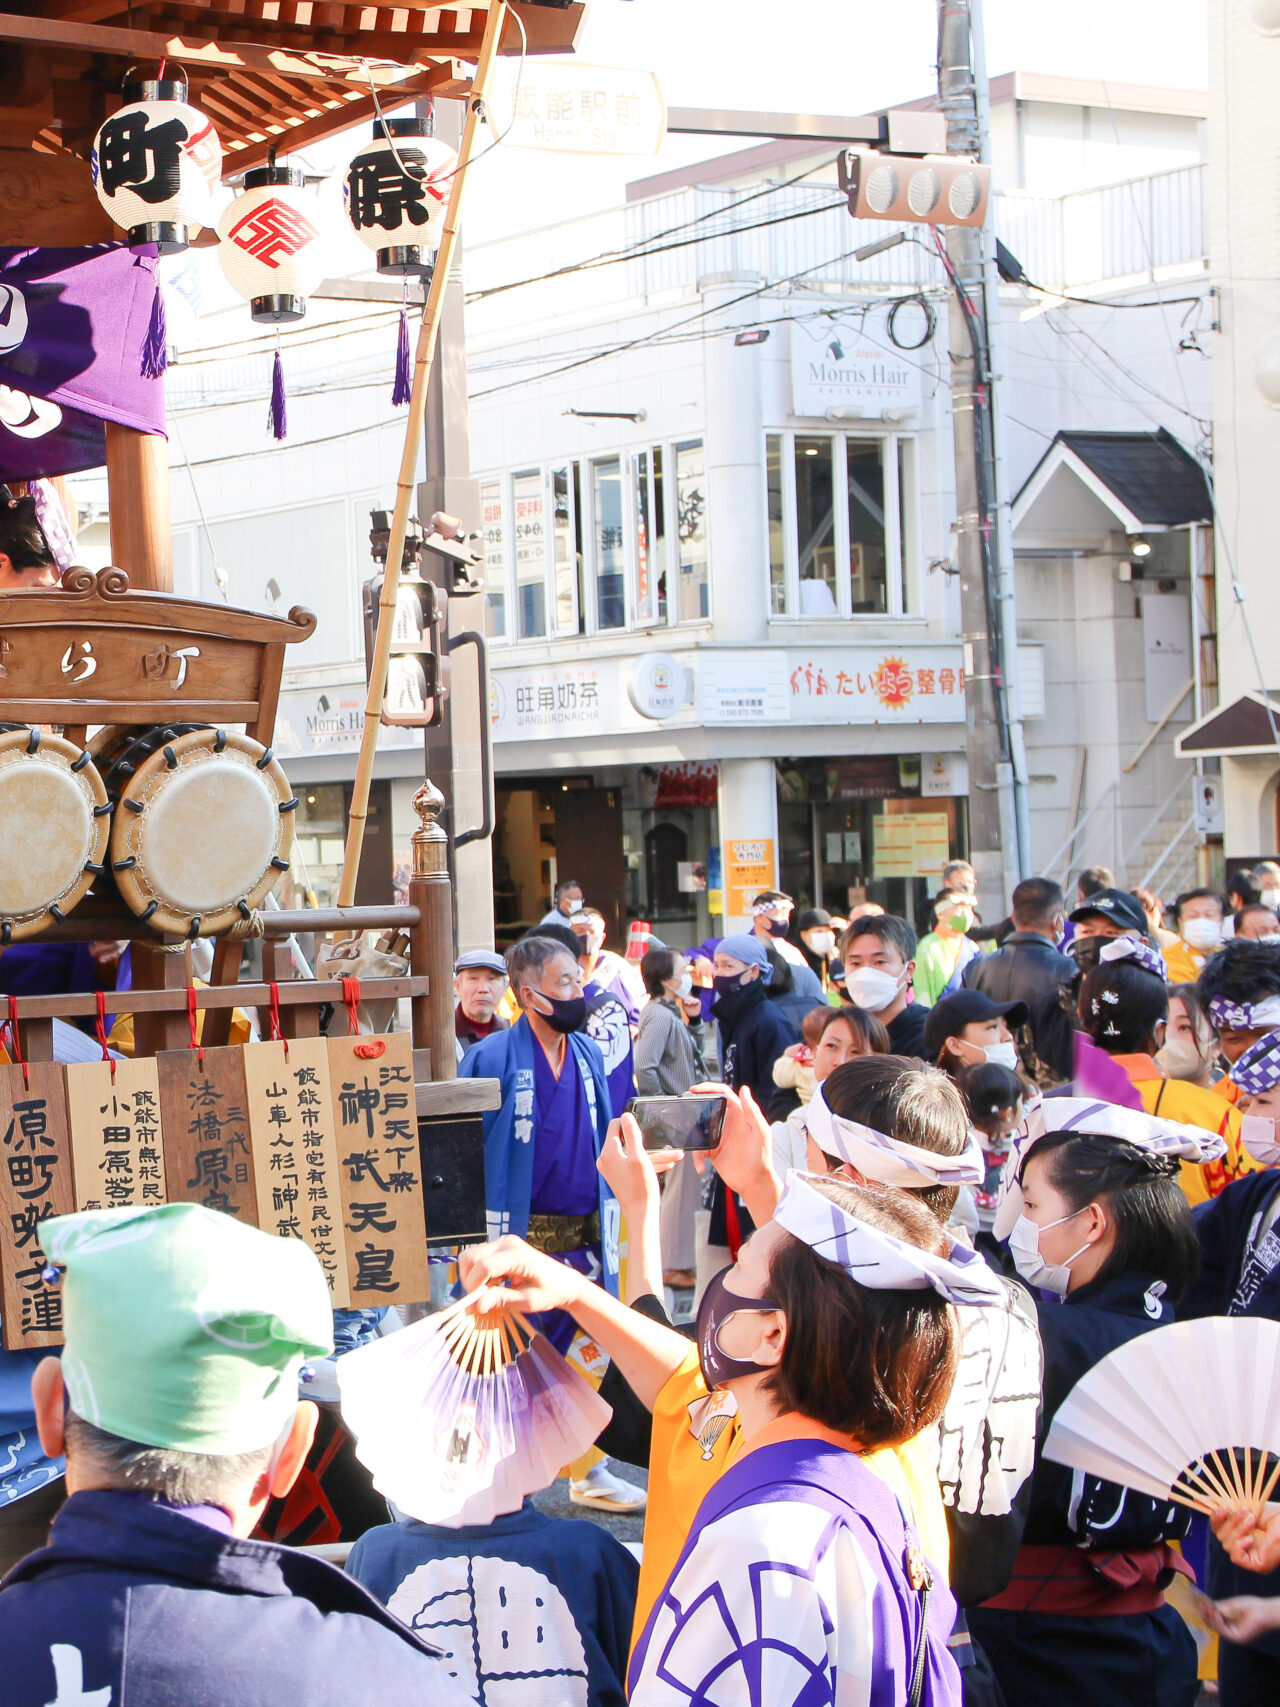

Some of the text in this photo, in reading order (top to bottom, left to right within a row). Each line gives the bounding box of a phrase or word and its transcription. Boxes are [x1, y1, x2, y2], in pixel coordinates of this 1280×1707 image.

[509, 84, 642, 127] 飯能駅前
[99, 110, 188, 204] 町
[349, 147, 429, 231] 原
[809, 361, 910, 386] Morris Hair
[306, 712, 345, 733] Morris
[516, 681, 600, 714] 旺角奶茶
[132, 1090, 164, 1207] 飯能市無形民
[222, 1106, 250, 1183] 三代目
[339, 1076, 400, 1292] 神武天皇
